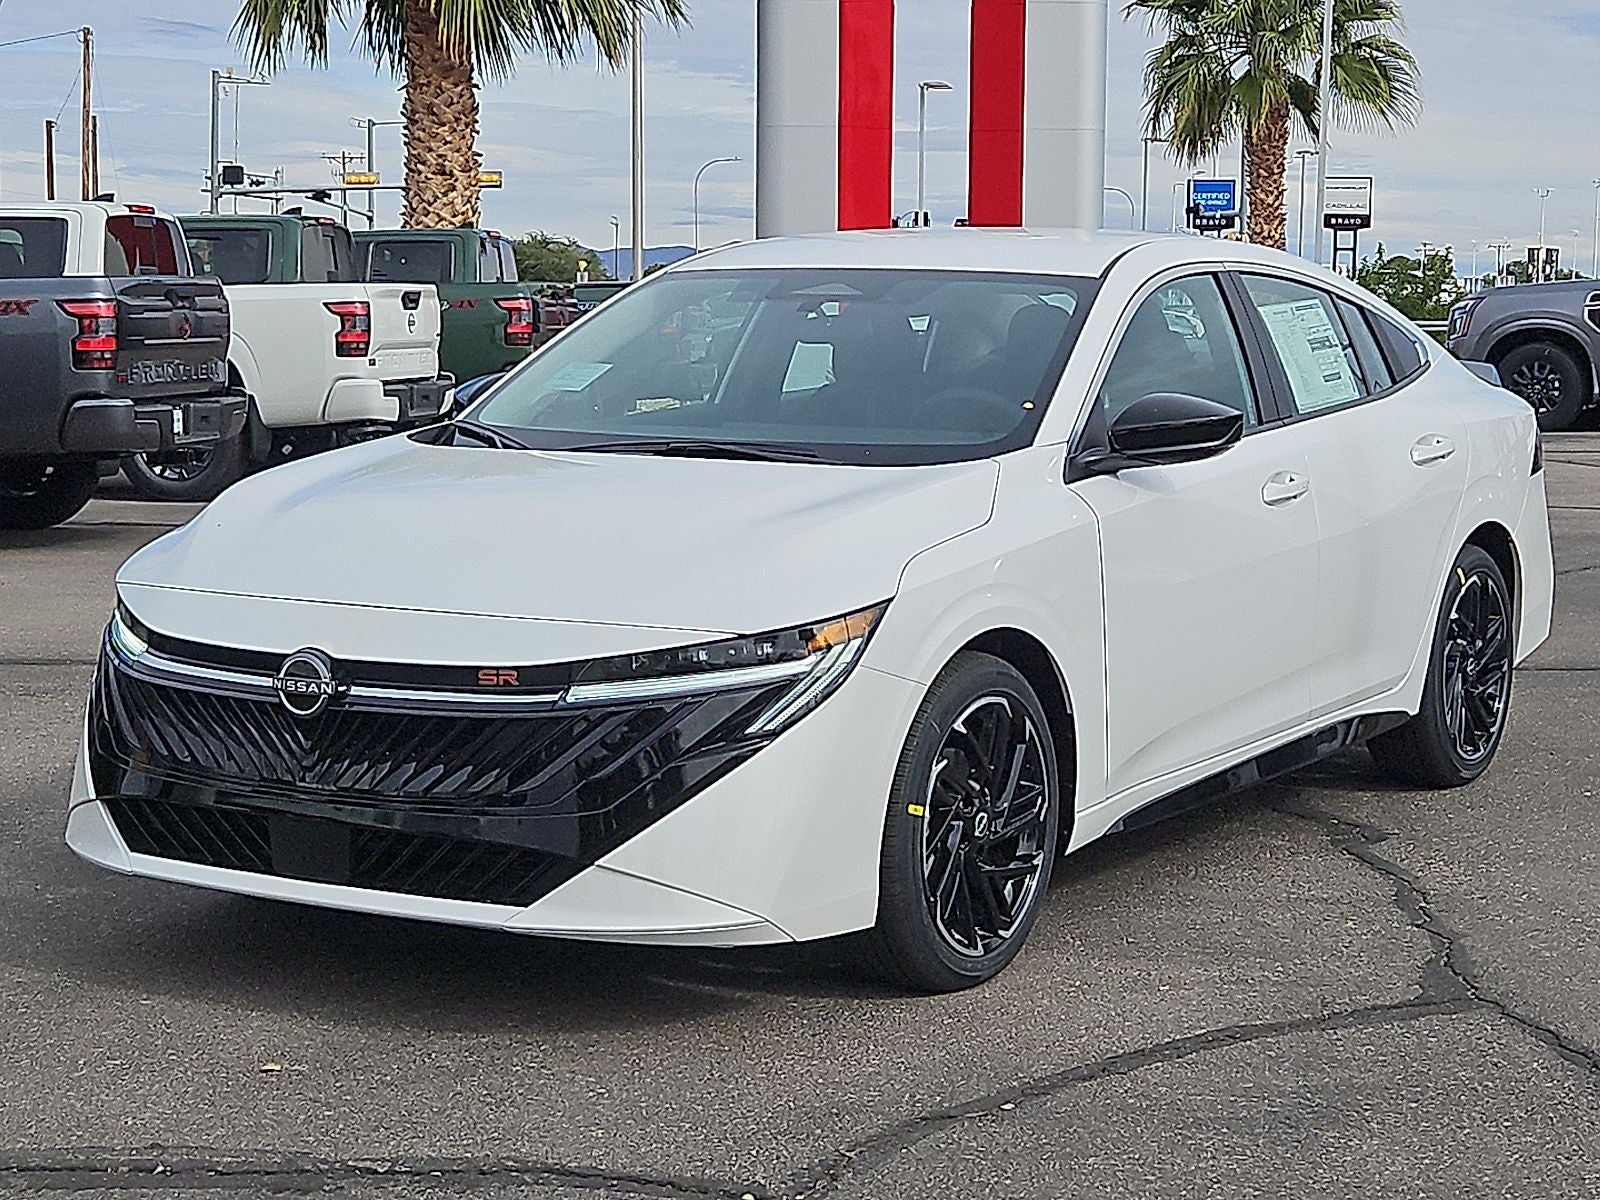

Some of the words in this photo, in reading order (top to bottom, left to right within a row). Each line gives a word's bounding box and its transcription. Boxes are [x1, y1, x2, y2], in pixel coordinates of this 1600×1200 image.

[1193, 192, 1231, 200] CERTIFIED
[1195, 218, 1226, 226] BRAVO
[1330, 217, 1362, 225] BRAVO
[478, 669, 520, 686] SR
[273, 678, 333, 695] NISSAN
